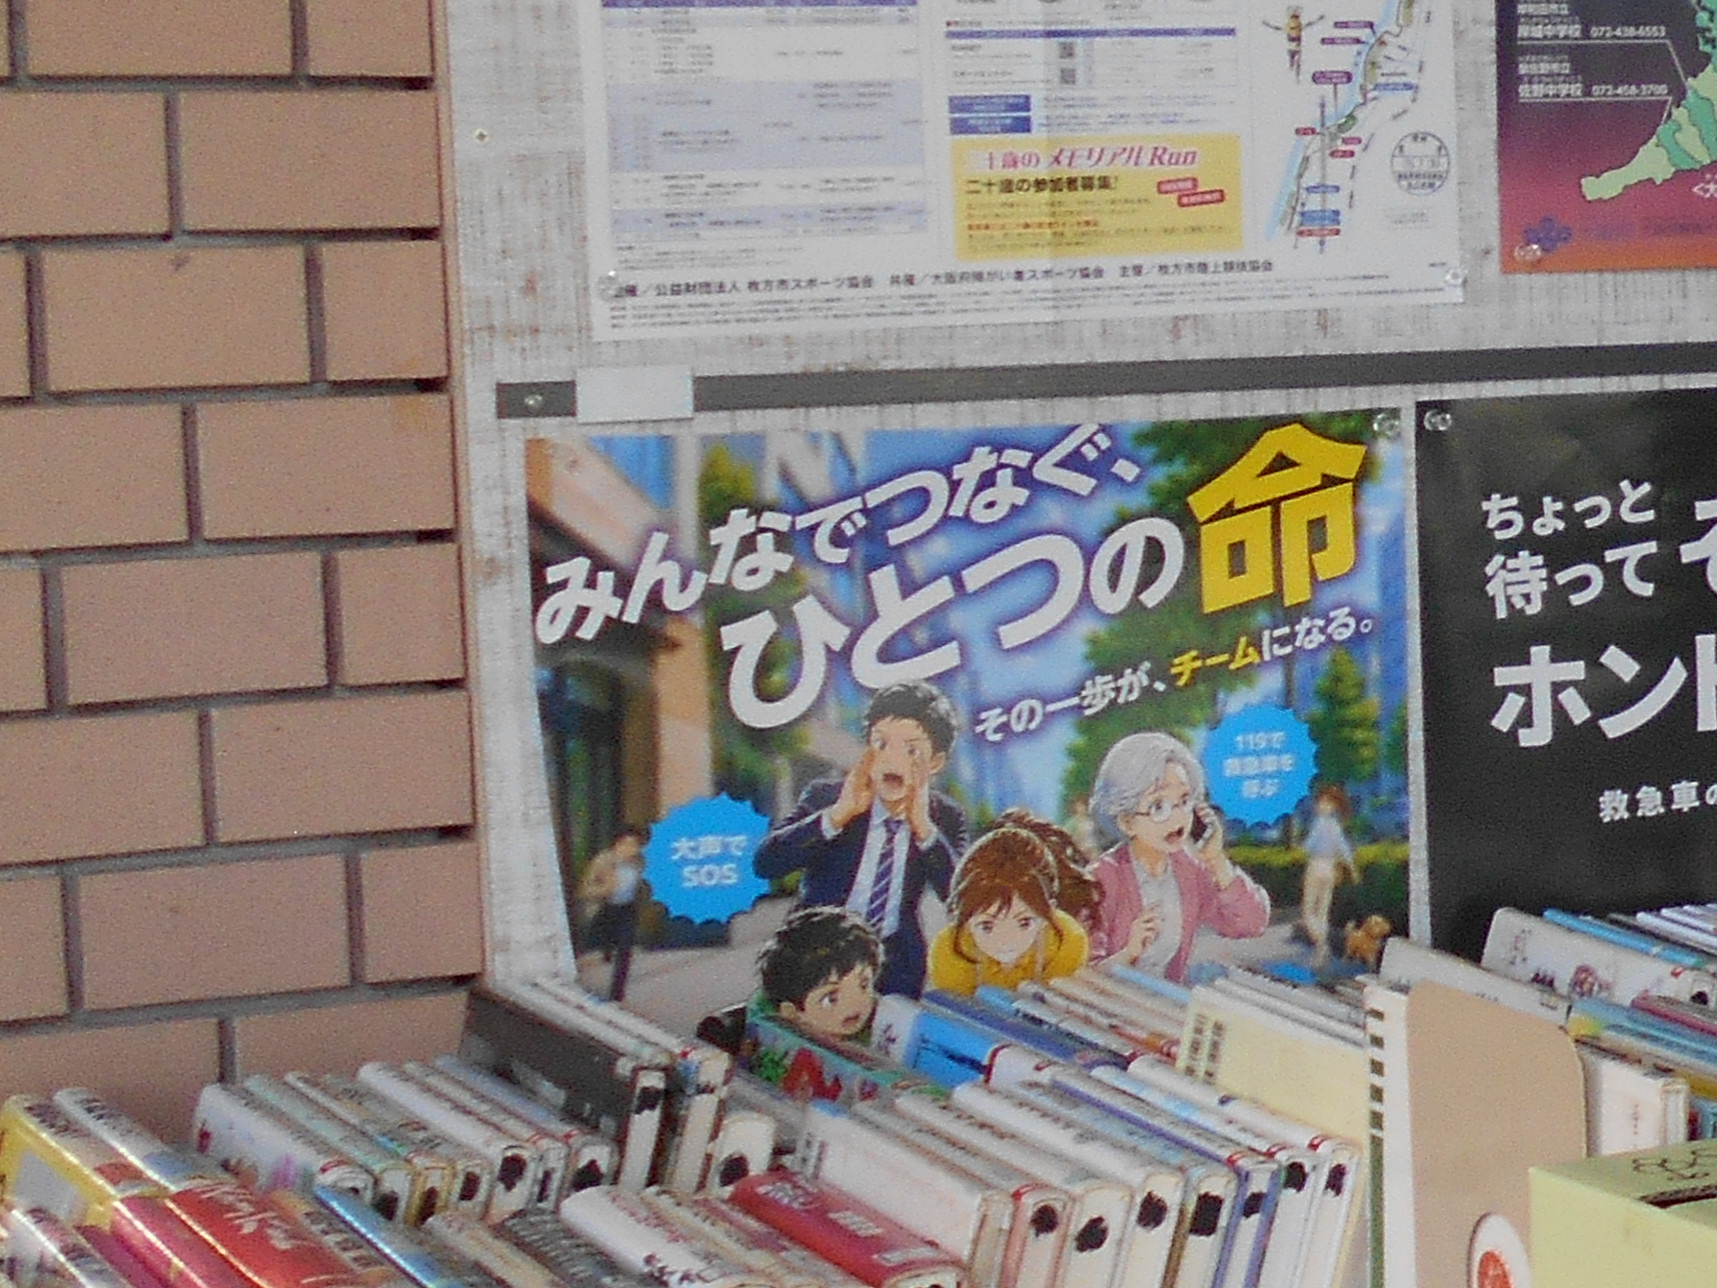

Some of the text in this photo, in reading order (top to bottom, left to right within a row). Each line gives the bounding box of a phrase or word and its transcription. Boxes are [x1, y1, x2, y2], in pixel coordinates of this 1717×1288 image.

[1149, 145, 1198, 168] Run
[535, 423, 1141, 646] みんなでつなぐ、
[1481, 479, 1656, 541] ちょっと
[1484, 540, 1659, 619] 待って
[974, 602, 1374, 744] その一歩が、チームになる。
[671, 834, 749, 861] 大声で
[682, 863, 739, 888] SOS
